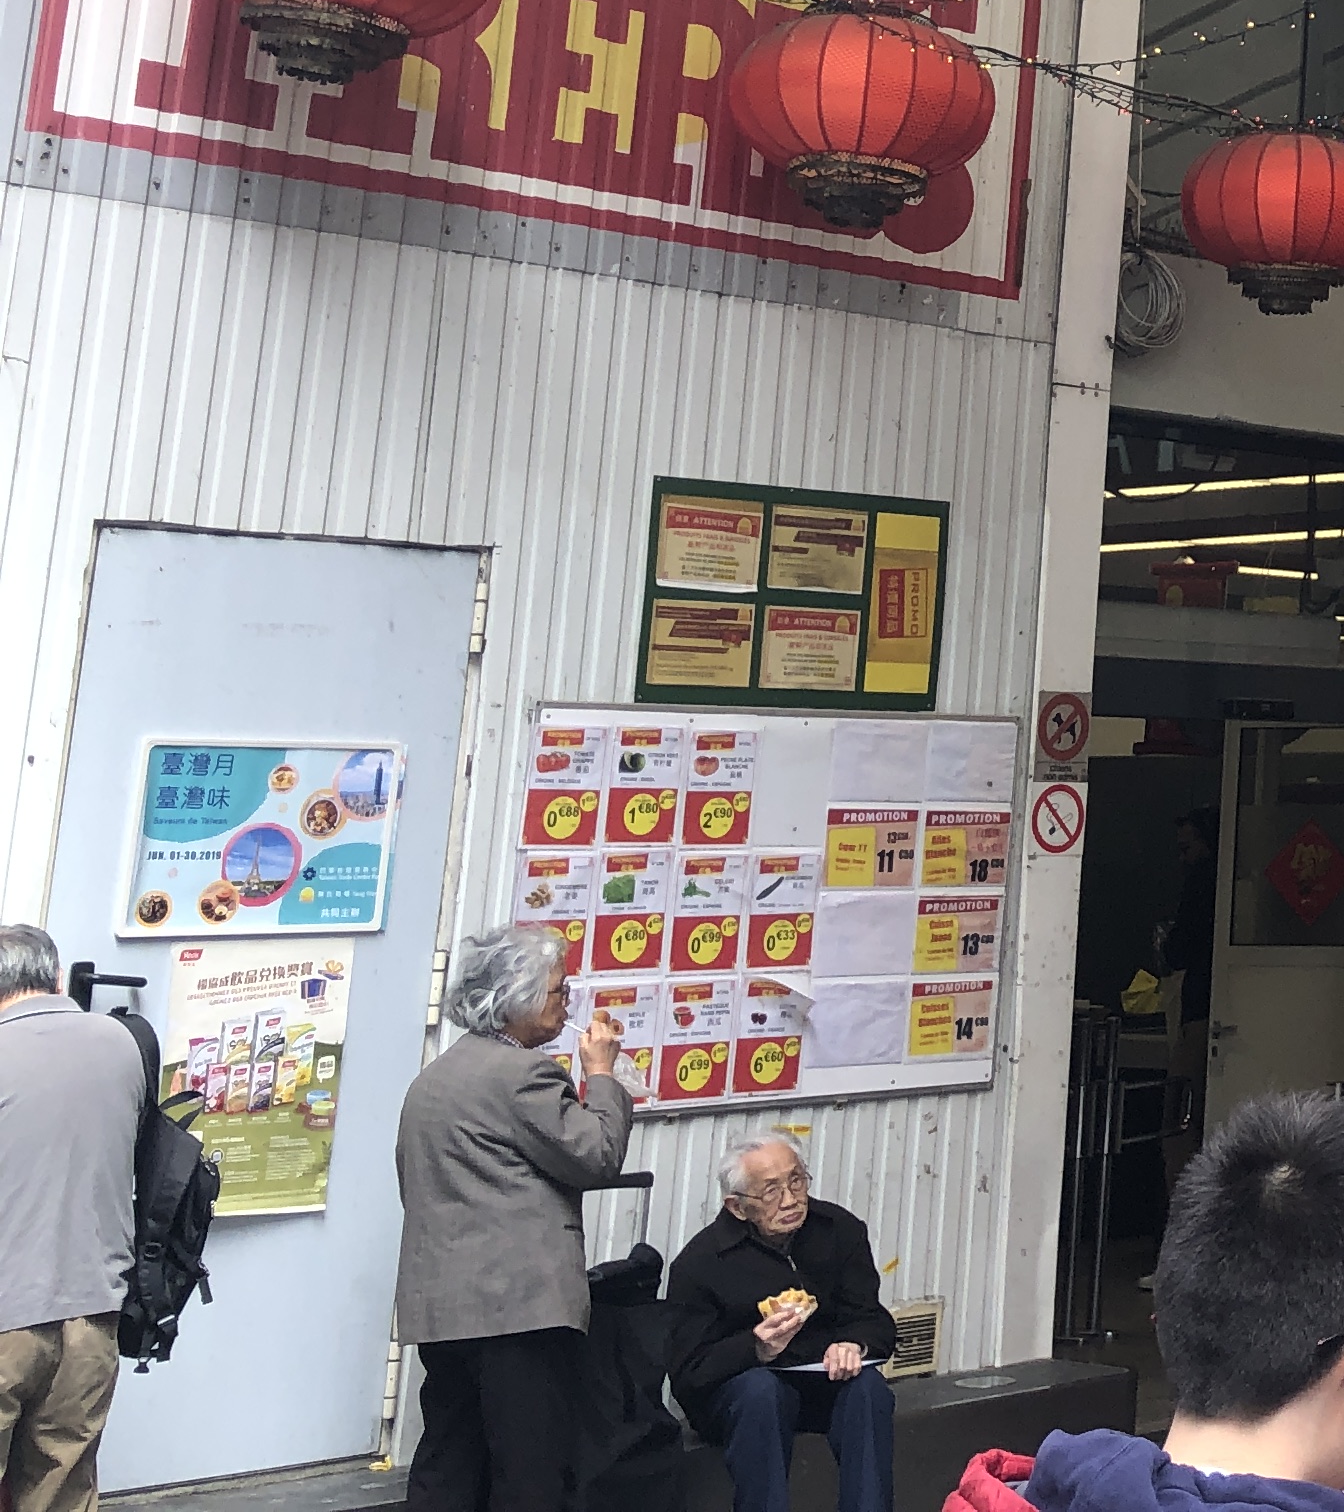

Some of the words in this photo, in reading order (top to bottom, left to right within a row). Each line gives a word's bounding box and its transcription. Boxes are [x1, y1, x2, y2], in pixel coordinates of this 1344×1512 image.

[693, 516, 734, 528] ATTENTION
[911, 572, 920, 635] PROMO
[793, 617, 833, 627] ATTENTION
[161, 753, 234, 776] 臺灣月
[155, 786, 230, 809] 臺灣味
[843, 811, 908, 822] PROMOTION
[931, 813, 1000, 825] PROMOTION
[925, 900, 991, 913] PROMOTION
[924, 981, 983, 995] PROMOTION
